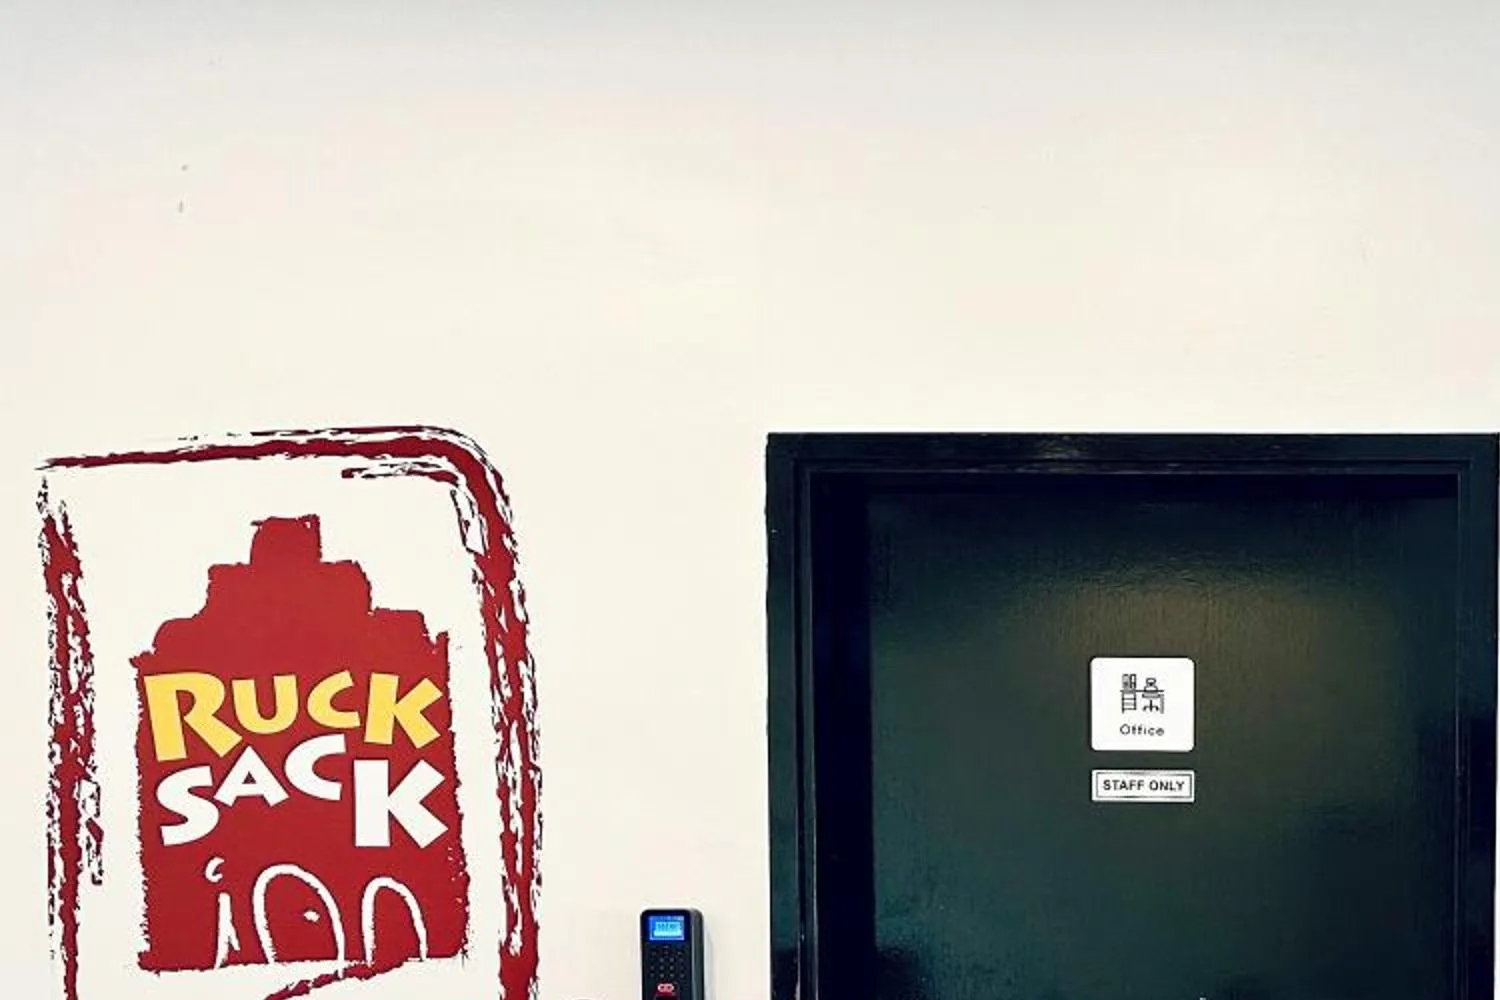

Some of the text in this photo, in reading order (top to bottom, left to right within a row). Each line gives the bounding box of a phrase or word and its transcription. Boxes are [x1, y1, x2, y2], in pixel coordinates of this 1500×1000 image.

[143, 670, 443, 762] RUCK
[1119, 723, 1165, 736] Office
[155, 733, 450, 849] SACK
[1103, 779, 1185, 791] STAFF ONLY
